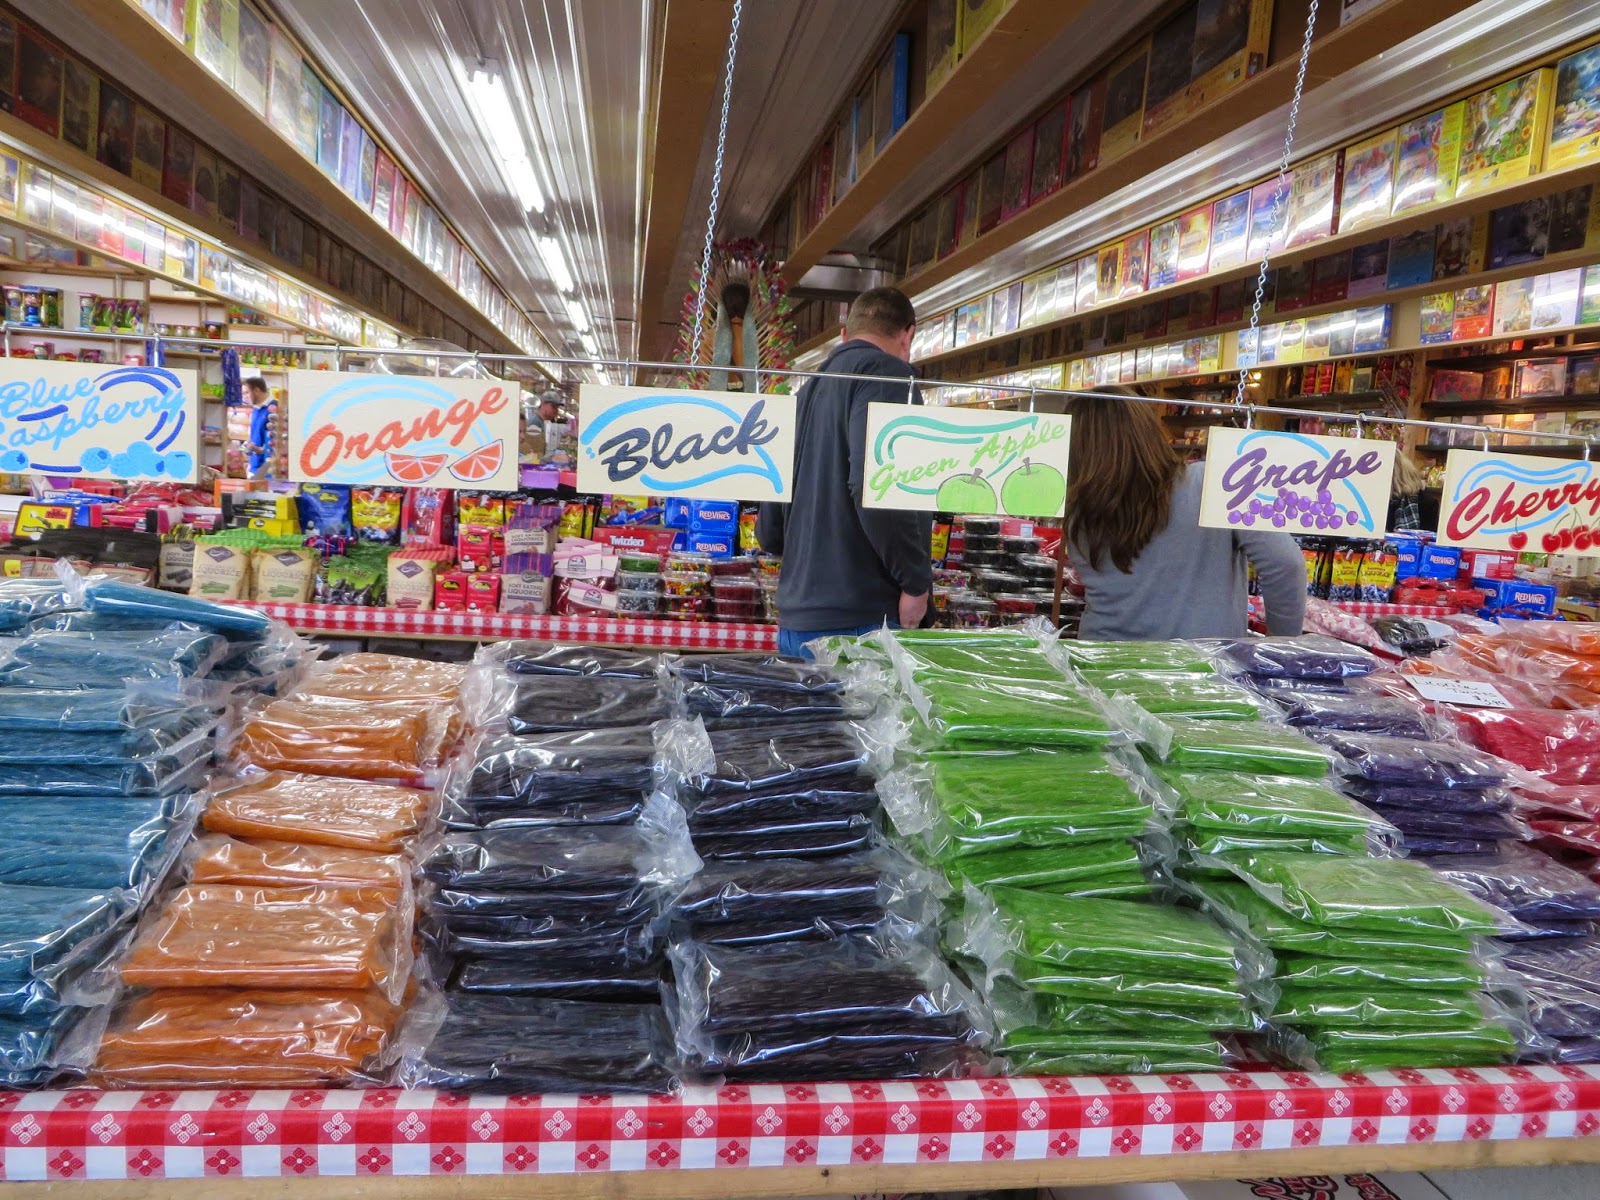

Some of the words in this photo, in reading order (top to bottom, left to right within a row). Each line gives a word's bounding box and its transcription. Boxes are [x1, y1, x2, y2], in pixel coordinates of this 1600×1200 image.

[0, 377, 96, 418] Blue
[0, 388, 186, 450] aspberry
[300, 387, 509, 478] Orange
[598, 399, 779, 482] Black
[869, 456, 961, 501] Green
[969, 419, 1066, 467] Apple
[1222, 447, 1382, 511] Grape
[1446, 477, 1600, 541] Cherry
